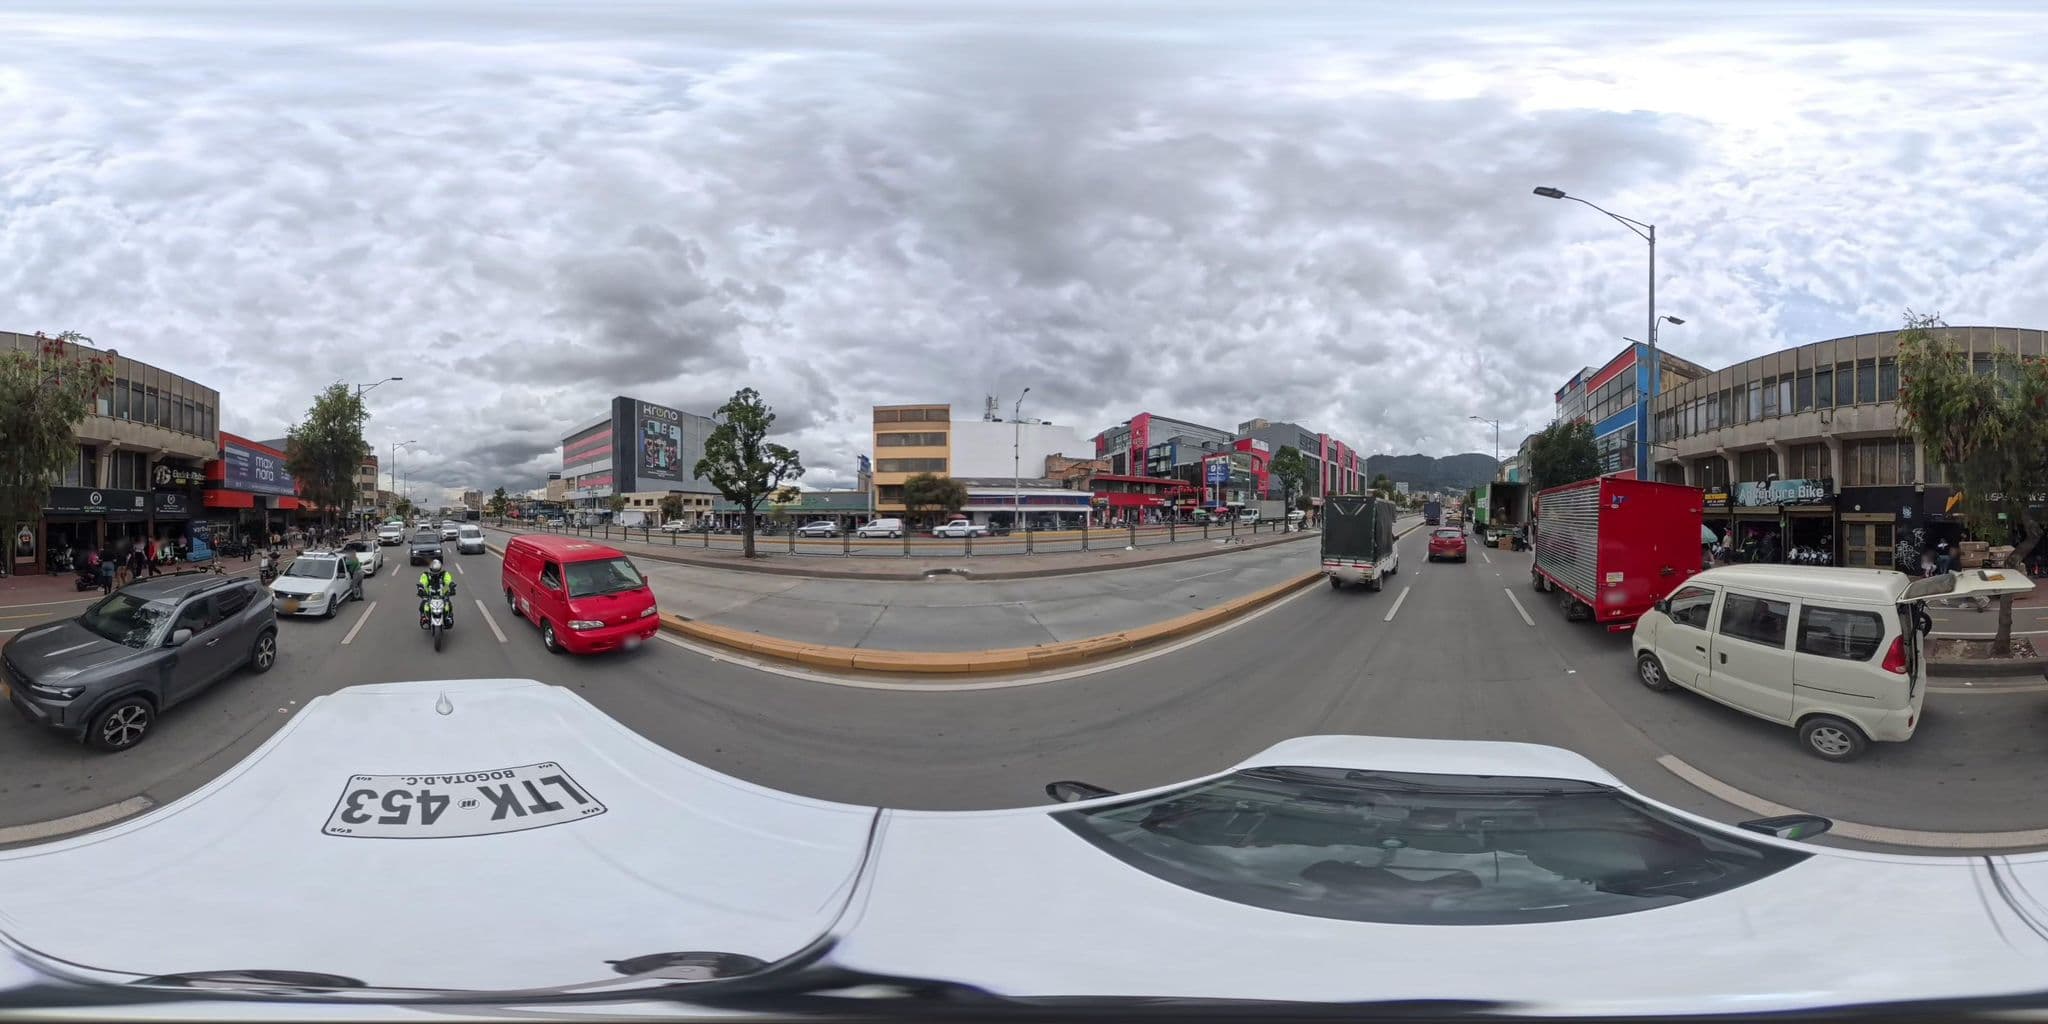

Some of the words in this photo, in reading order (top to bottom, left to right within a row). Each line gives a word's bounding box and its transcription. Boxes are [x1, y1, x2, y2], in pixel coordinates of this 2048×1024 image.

[1798, 485, 1825, 498] Bike
[340, 788, 451, 826] 453
[477, 774, 589, 821] LTK
